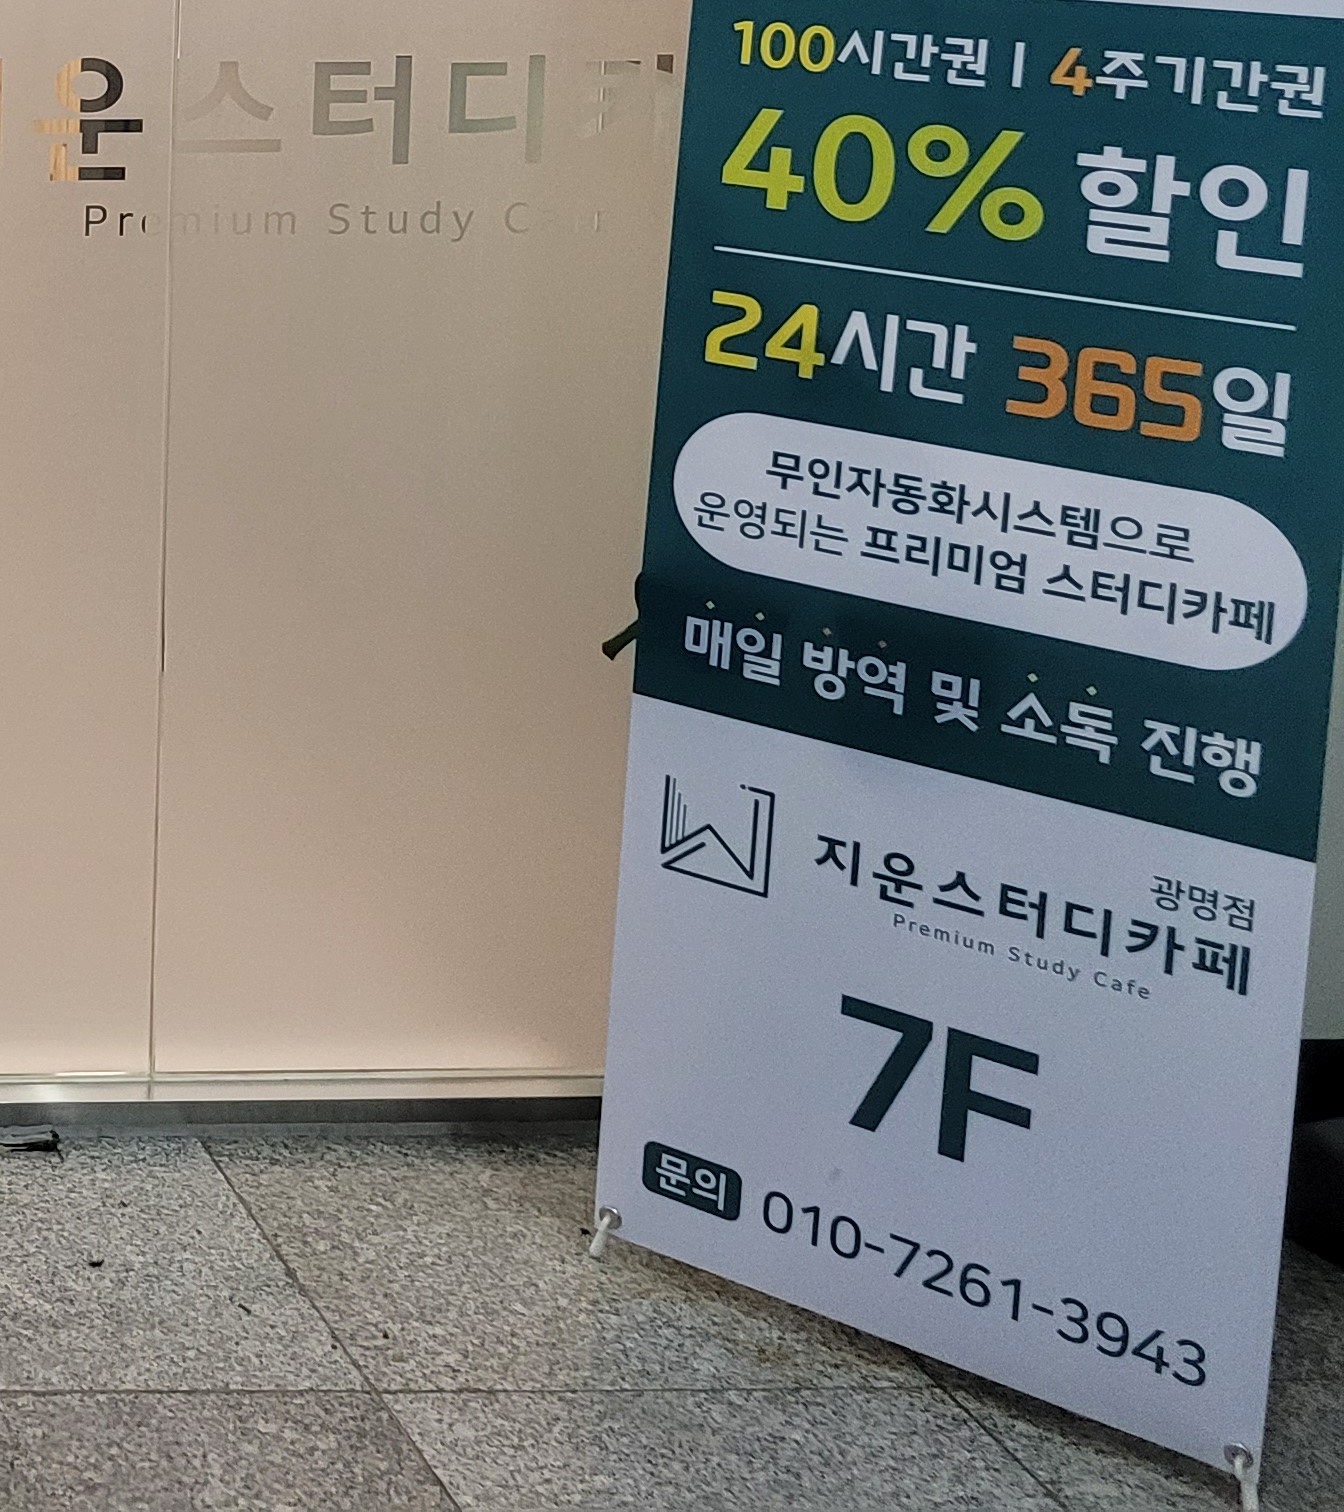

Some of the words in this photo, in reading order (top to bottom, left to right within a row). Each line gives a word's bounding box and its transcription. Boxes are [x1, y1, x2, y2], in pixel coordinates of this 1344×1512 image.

[732, 20, 988, 87] 100시간권
[1049, 47, 1326, 119] 4주기간권
[328, 200, 474, 241] Study
[720, 107, 1045, 241] 40%
[1076, 146, 1309, 278] 할인
[704, 290, 977, 404] 24시간
[1006, 336, 1291, 457] 365일
[693, 491, 850, 558] 운영되는
[860, 525, 1027, 594] 프리미엄
[1041, 562, 1276, 645] 스터디카페
[765, 451, 1195, 564] 무인자동화시스템으로
[684, 615, 783, 688] 매일
[802, 640, 907, 715] 방역
[931, 672, 981, 733] 및
[1000, 694, 1118, 765] 소독
[1141, 718, 1263, 799] 진행
[814, 834, 1251, 996] 지운스터디카페
[893, 912, 996, 956] Premium
[1008, 945, 1080, 982] Study
[1094, 969, 1152, 1000] Cafe
[1149, 875, 1257, 932] 광명점
[841, 994, 1040, 1163] 7F
[654, 1152, 729, 1211] 문의
[762, 1189, 1207, 1388] 010-7261-3943
